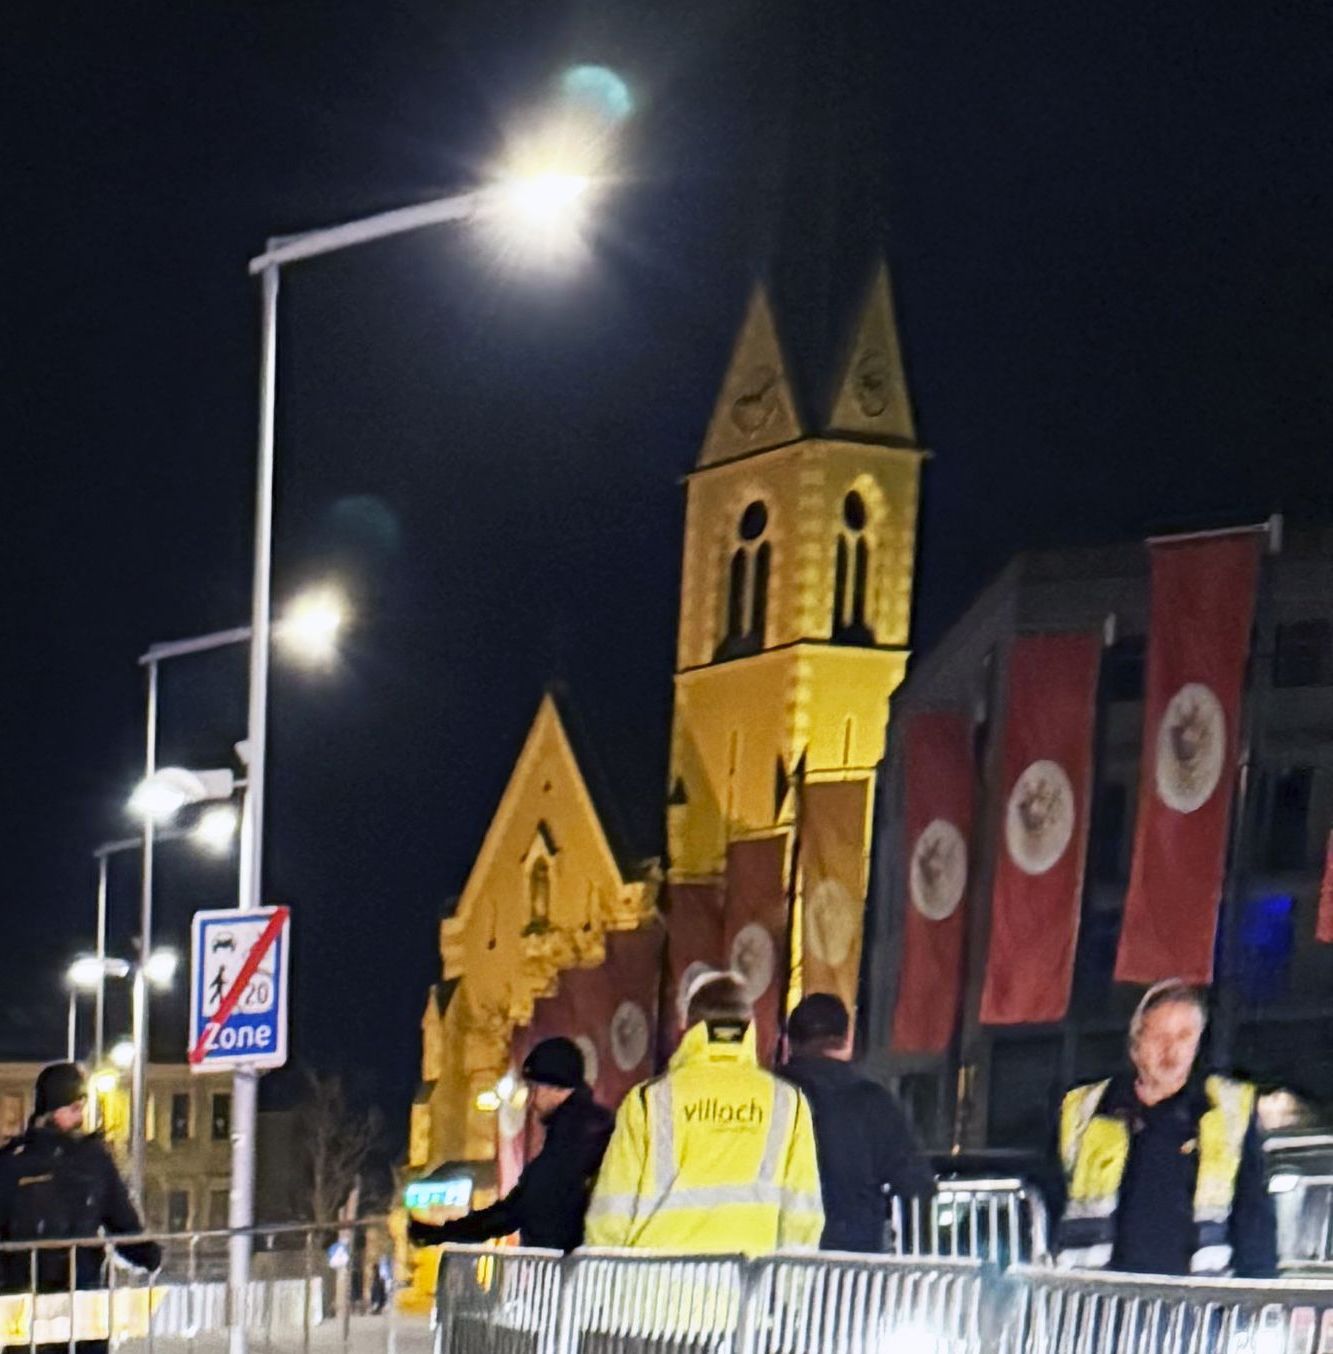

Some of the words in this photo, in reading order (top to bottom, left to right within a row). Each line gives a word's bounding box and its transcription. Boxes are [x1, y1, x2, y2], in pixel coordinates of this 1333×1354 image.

[245, 982, 269, 1005] 20
[203, 1021, 272, 1050] Zone
[683, 1097, 764, 1124] villach
